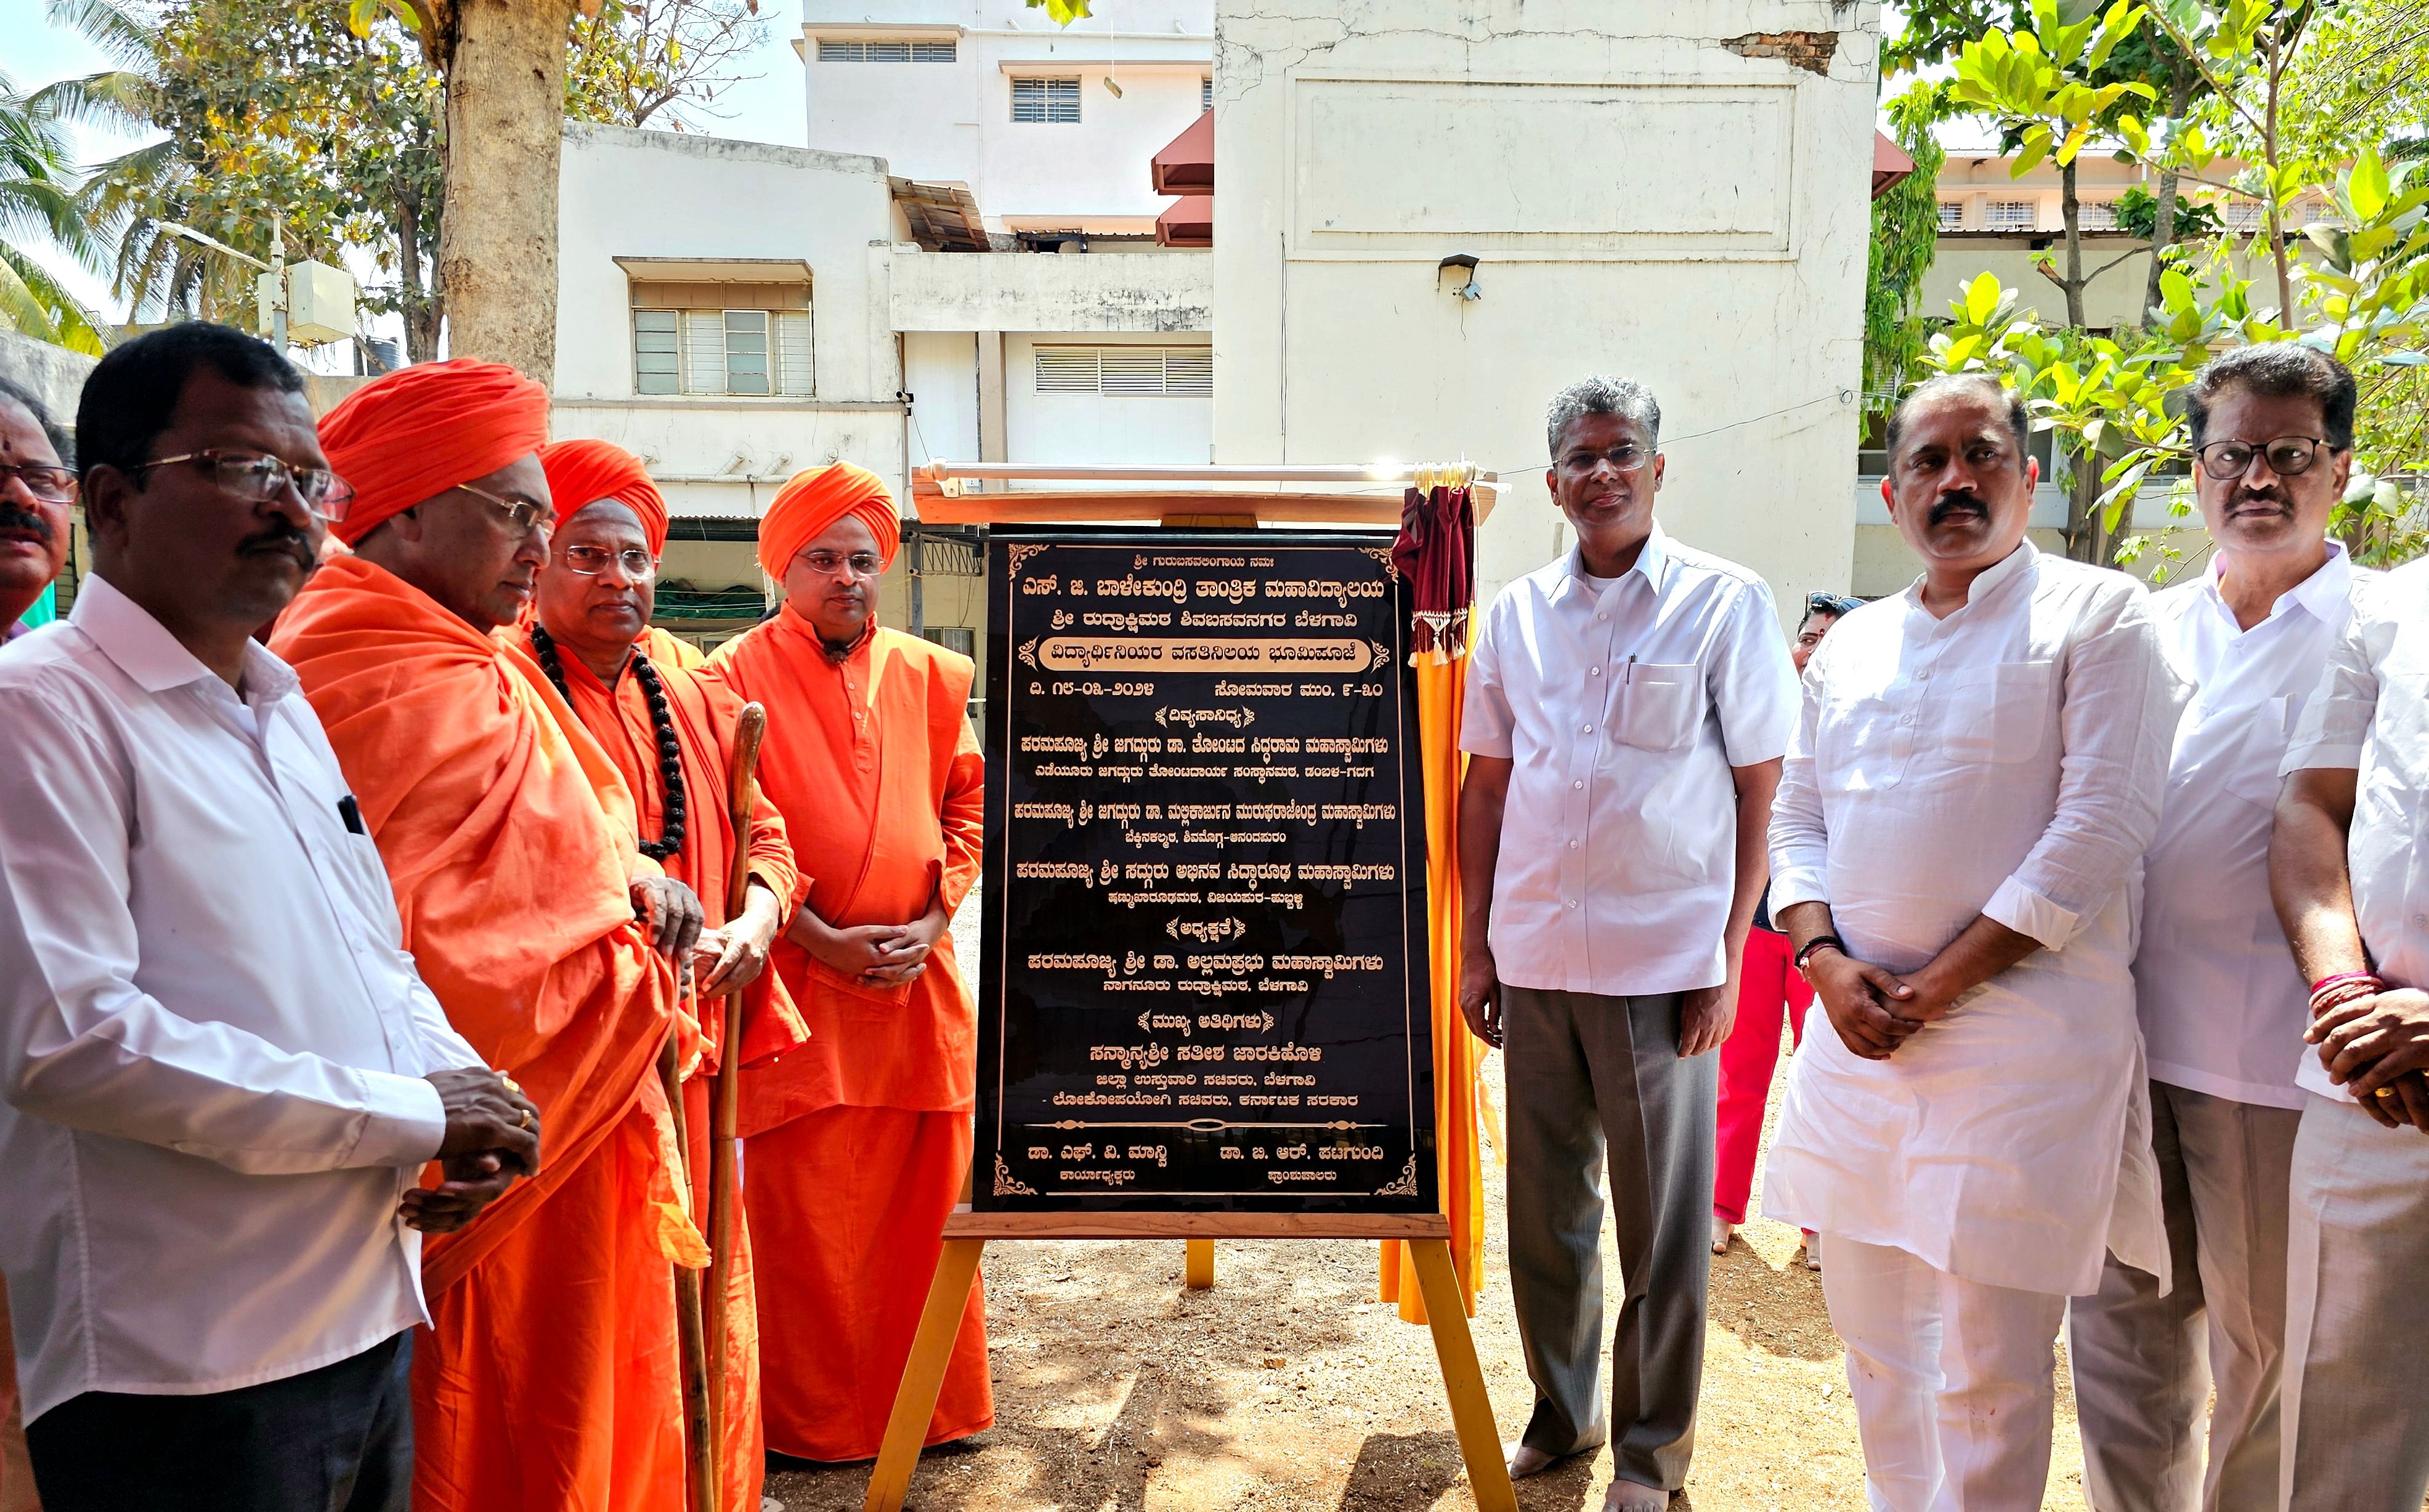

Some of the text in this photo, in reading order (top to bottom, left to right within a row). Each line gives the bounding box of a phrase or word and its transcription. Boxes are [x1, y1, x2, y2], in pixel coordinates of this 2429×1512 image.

[1133, 554, 1275, 570] ಶ್ರೀ ಗುರುಬಸವಲಿಂಗಾಯ ನಮಃ
[1023, 573, 1384, 608] ಎಸ್. ಜಿ. ಬಾಳೇಕುಂದ್ರಿ ತಾಂತ್ರಿಕ ಮಹಾವಿದ್ಯಾಲಯ
[1050, 608, 1358, 634] ಶ್ರೀ ರುದ್ರಾಕ್ಷಿಮಠ ಶಿವಬಸವನಗರ ಬೆಳಗಾವಿ
[1051, 642, 1356, 668] ವಿದ್ಯಾರ್ಥಿನಿಯರ ವಸತಿನಿಲಯ ಭೂಮಿಪೂಜೆ
[1029, 681, 1045, 695] ದಿ.
[1215, 679, 1293, 697] ಸೋಮವಾರ
[1299, 683, 1336, 697] ಮುಂ.
[1169, 708, 1242, 729] ದಿವ್ಯಸಾನಿಧ್ಯ
[1021, 735, 1088, 762] ಪರಮಪೂಜ್ಯ
[1092, 733, 1109, 759] ಶ್ರೀ
[1114, 736, 1161, 763] ಜಗದ್ಗುರು
[1167, 738, 1186, 753] ಡಾ.
[1192, 732, 1246, 753] ತೋಂಟದ
[1305, 736, 1389, 763] ಮಹಾಸ್ವಾಮಿಗಳು
[1035, 762, 1093, 777] ಎಡೆಯೂರು
[1098, 766, 1143, 783] ಜಗದ್ಗುರು
[1304, 766, 1374, 778] ಡಂಬಳ-ಗದಗ
[1014, 802, 1074, 829] ಪರಮಪೂಜ್ಯ
[1078, 799, 1093, 826] ಶ್ರೀ
[1098, 802, 1141, 830] ಜಗದ್ಗುರು
[1145, 804, 1163, 820] ಡಾ.
[1167, 802, 1231, 827] ಮಲ್ಲಿಕಾರ್ಜುನ
[1321, 802, 1396, 830] ಮಹಾಸ್ವಾಮಿಗಳು
[1016, 861, 1094, 889] ಪರಮಪೂಜ್ಯ
[1099, 859, 1119, 886] ಶ್ರೀ
[1125, 862, 1169, 889] ಸದ್ಗುರು
[1175, 862, 1220, 883] ಅಭಿನವ
[1297, 862, 1395, 890] ಮಹಾಸ್ವಾಮಿಗಳು
[1180, 918, 1231, 943] ಅಧ್ಯಕ್ಷತೆ
[1028, 950, 1384, 979] ಪರಮಪೂಜ್ಯ ಶ್ರೀ ಡಾ. ಅಲ್ಲಮಪ್ರಭು ಮಹಾಸ್ವಾಮಿಗಳು
[1103, 979, 1171, 991] ನಾಗನೂರು
[1258, 977, 1308, 992] ಬೆಳಗಾವಿ
[1152, 1013, 1191, 1037] ಮುಖ್ಯ
[1177, 1044, 1225, 1061] ಸತೀಶ
[1233, 1041, 1322, 1062] ಜಾರಕಿಹೊಳಿ
[1096, 1075, 1127, 1090] ಜಿಲ್ಲಾ
[1133, 1073, 1197, 1091] ಉಸ್ತುವಾರಿ
[1263, 1071, 1316, 1086] ಬೆಳಗಾವಿ
[1052, 1091, 1172, 1106] ಲೋಕೋಪಯೋಗಿ
[1239, 1094, 1300, 1106] ಕರ್ನಾಟಕ
[1307, 1094, 1358, 1106] ಸರಕಾರ
[1028, 1147, 1053, 1160] ಡಾ.
[1104, 1145, 1121, 1159] ವಿ.
[1220, 1142, 1384, 1160] ಡಾ. ಬಿ. ಆರ್. ಪಟಗುಂದಿ
[1060, 1170, 1135, 1186] ಕಾರ್ಯಾಧ್ಯಕ್ಷರು
